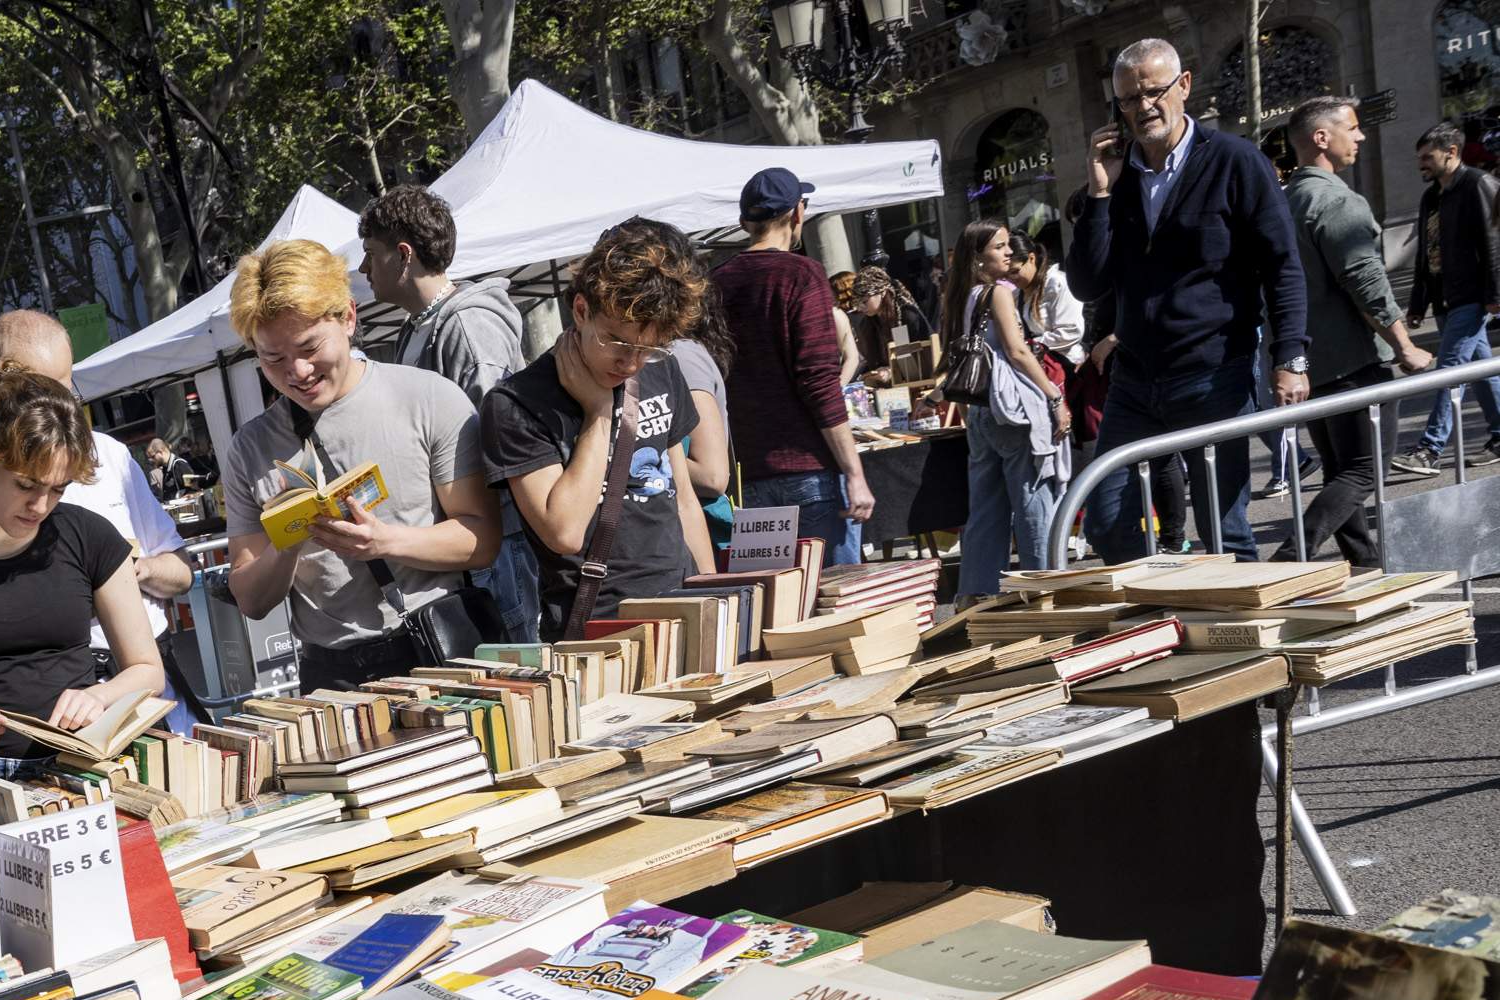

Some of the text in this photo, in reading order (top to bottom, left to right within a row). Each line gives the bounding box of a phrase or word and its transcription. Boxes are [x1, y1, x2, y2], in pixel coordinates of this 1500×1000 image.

[1239, 105, 1295, 125] RUALS
[740, 520, 776, 534] LLIBRE
[778, 519, 791, 532] 3€
[731, 547, 737, 559] 2
[738, 547, 773, 559] LLIBRES
[774, 545, 782, 557] 5
[76, 819, 89, 836] 3
[80, 854, 93, 870] 5
[3, 859, 33, 886] LLIBRE
[5, 899, 34, 922] LLIBRES
